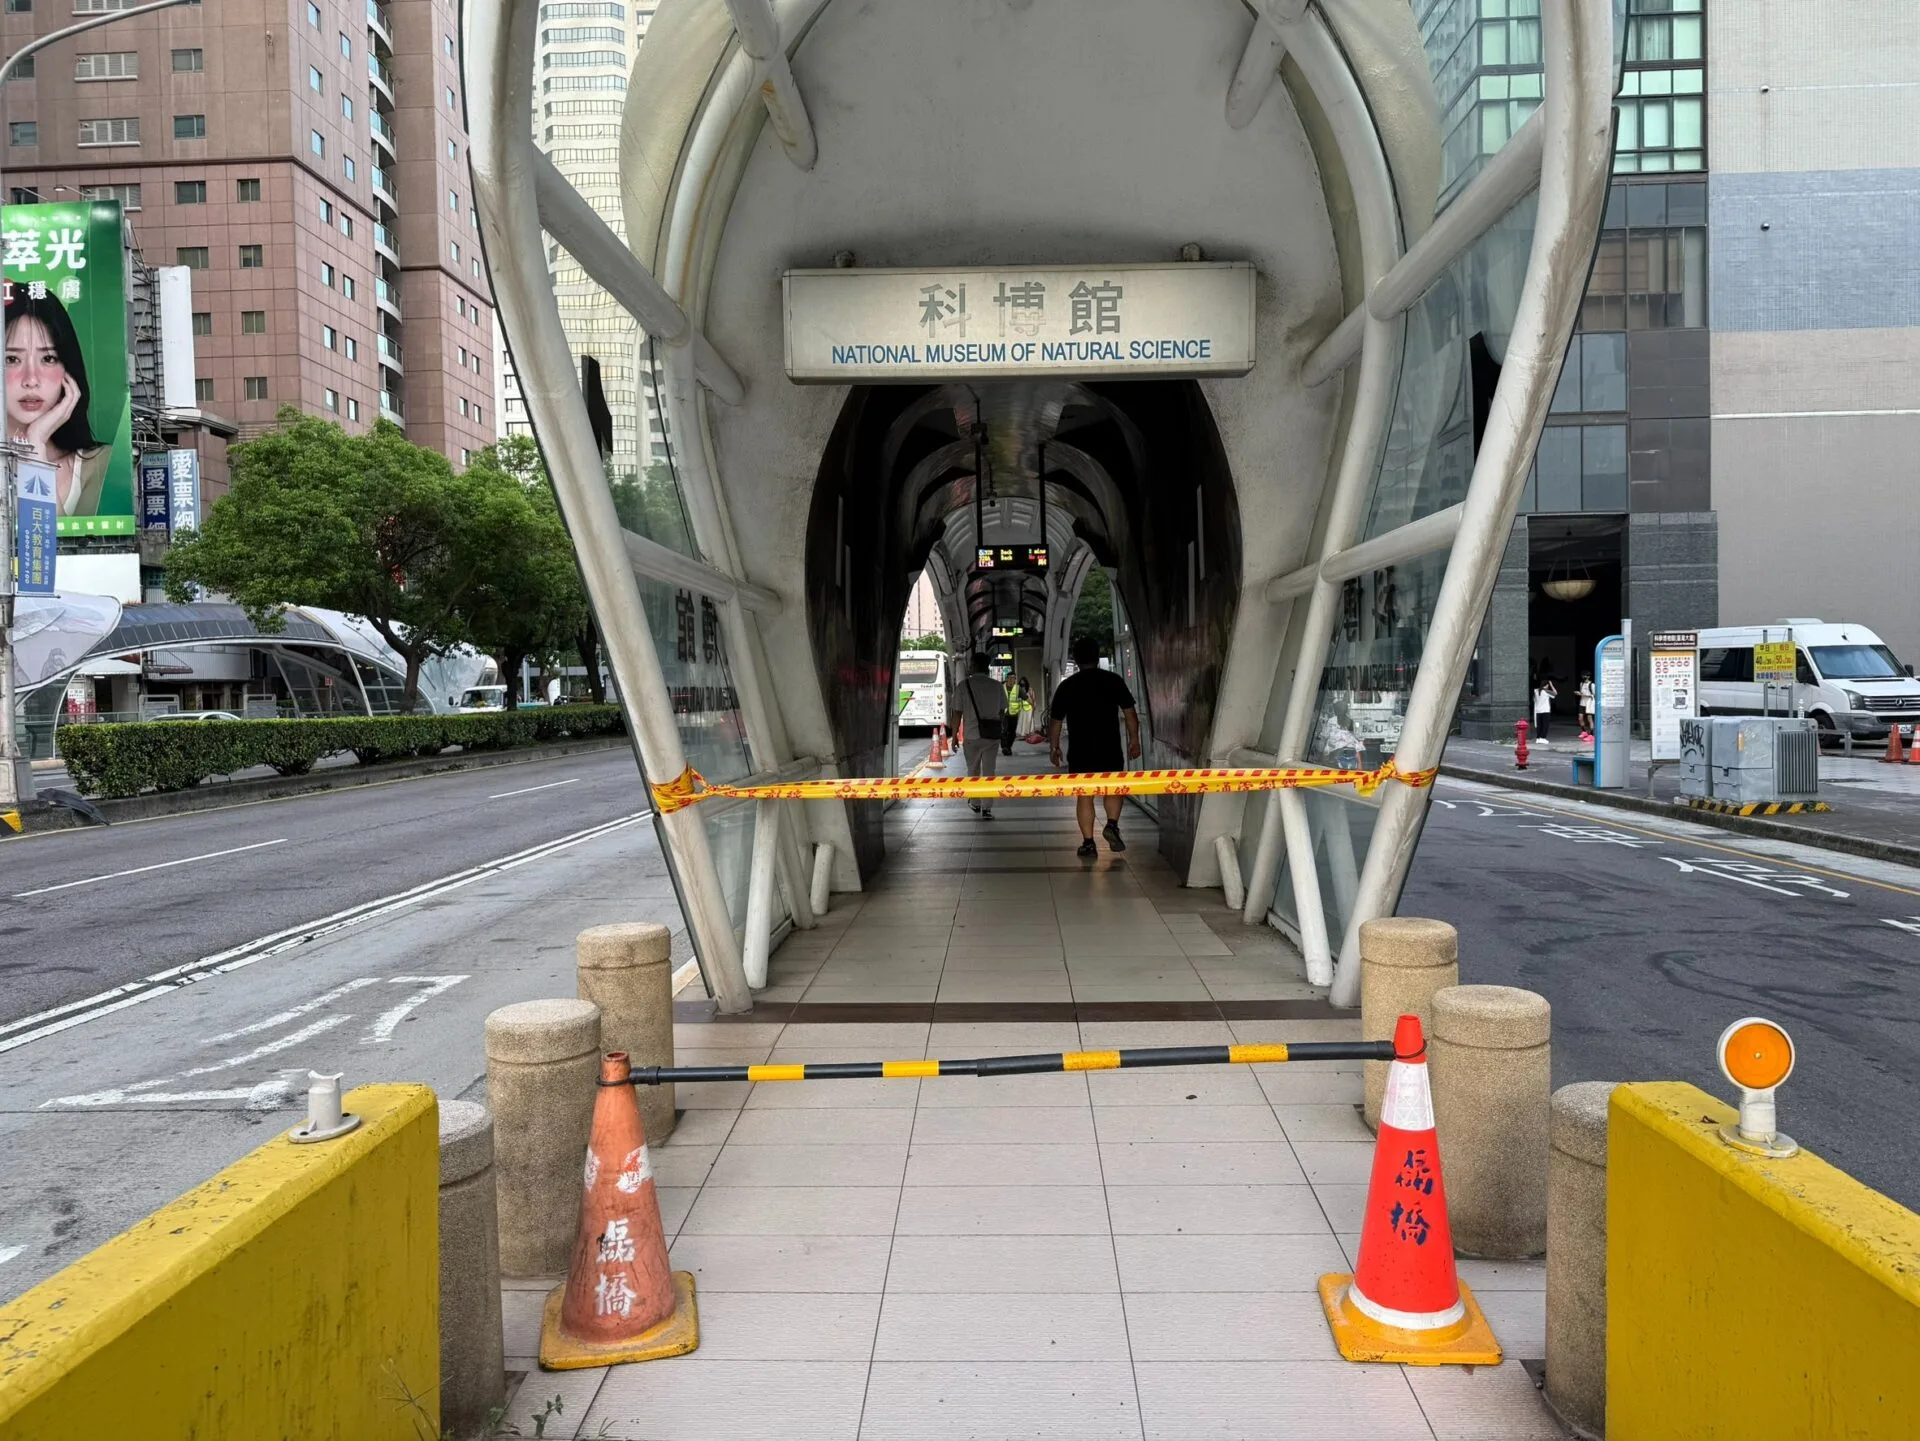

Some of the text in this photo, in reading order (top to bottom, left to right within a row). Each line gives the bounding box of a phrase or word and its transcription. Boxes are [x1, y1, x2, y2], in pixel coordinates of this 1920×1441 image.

[919, 280, 1124, 338] 科博館
[832, 339, 1211, 364] NATIONAL MUSEUM OF NATURAL SCIENCE
